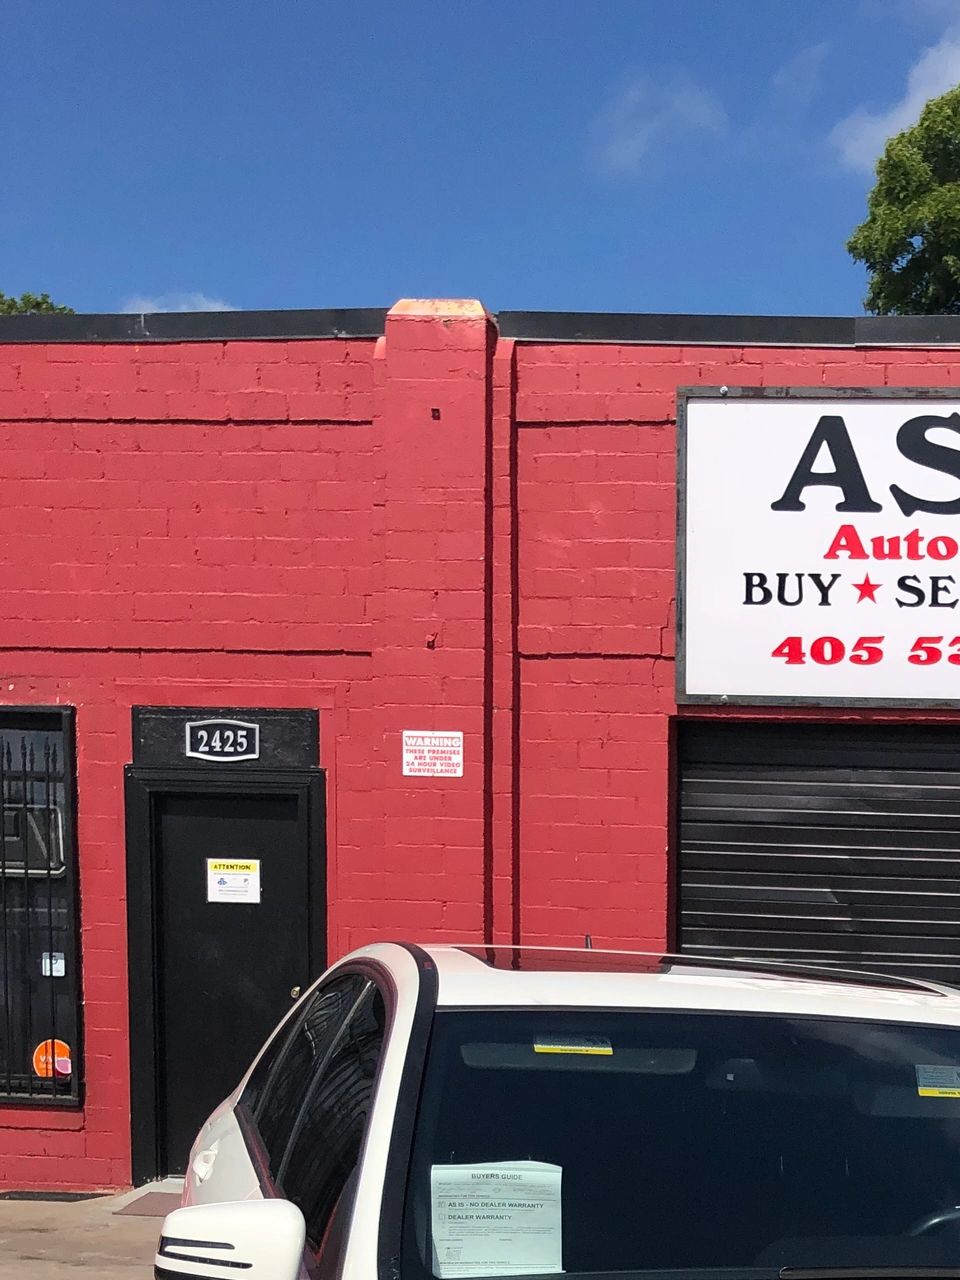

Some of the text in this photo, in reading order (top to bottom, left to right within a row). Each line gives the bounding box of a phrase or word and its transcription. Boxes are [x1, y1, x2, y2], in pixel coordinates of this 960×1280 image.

[823, 524, 959, 561] Auto
[742, 572, 842, 606] BUY
[771, 636, 885, 666] 405
[197, 730, 248, 752] 2425
[405, 736, 460, 747] WARNING
[213, 863, 251, 871] ATTENTION
